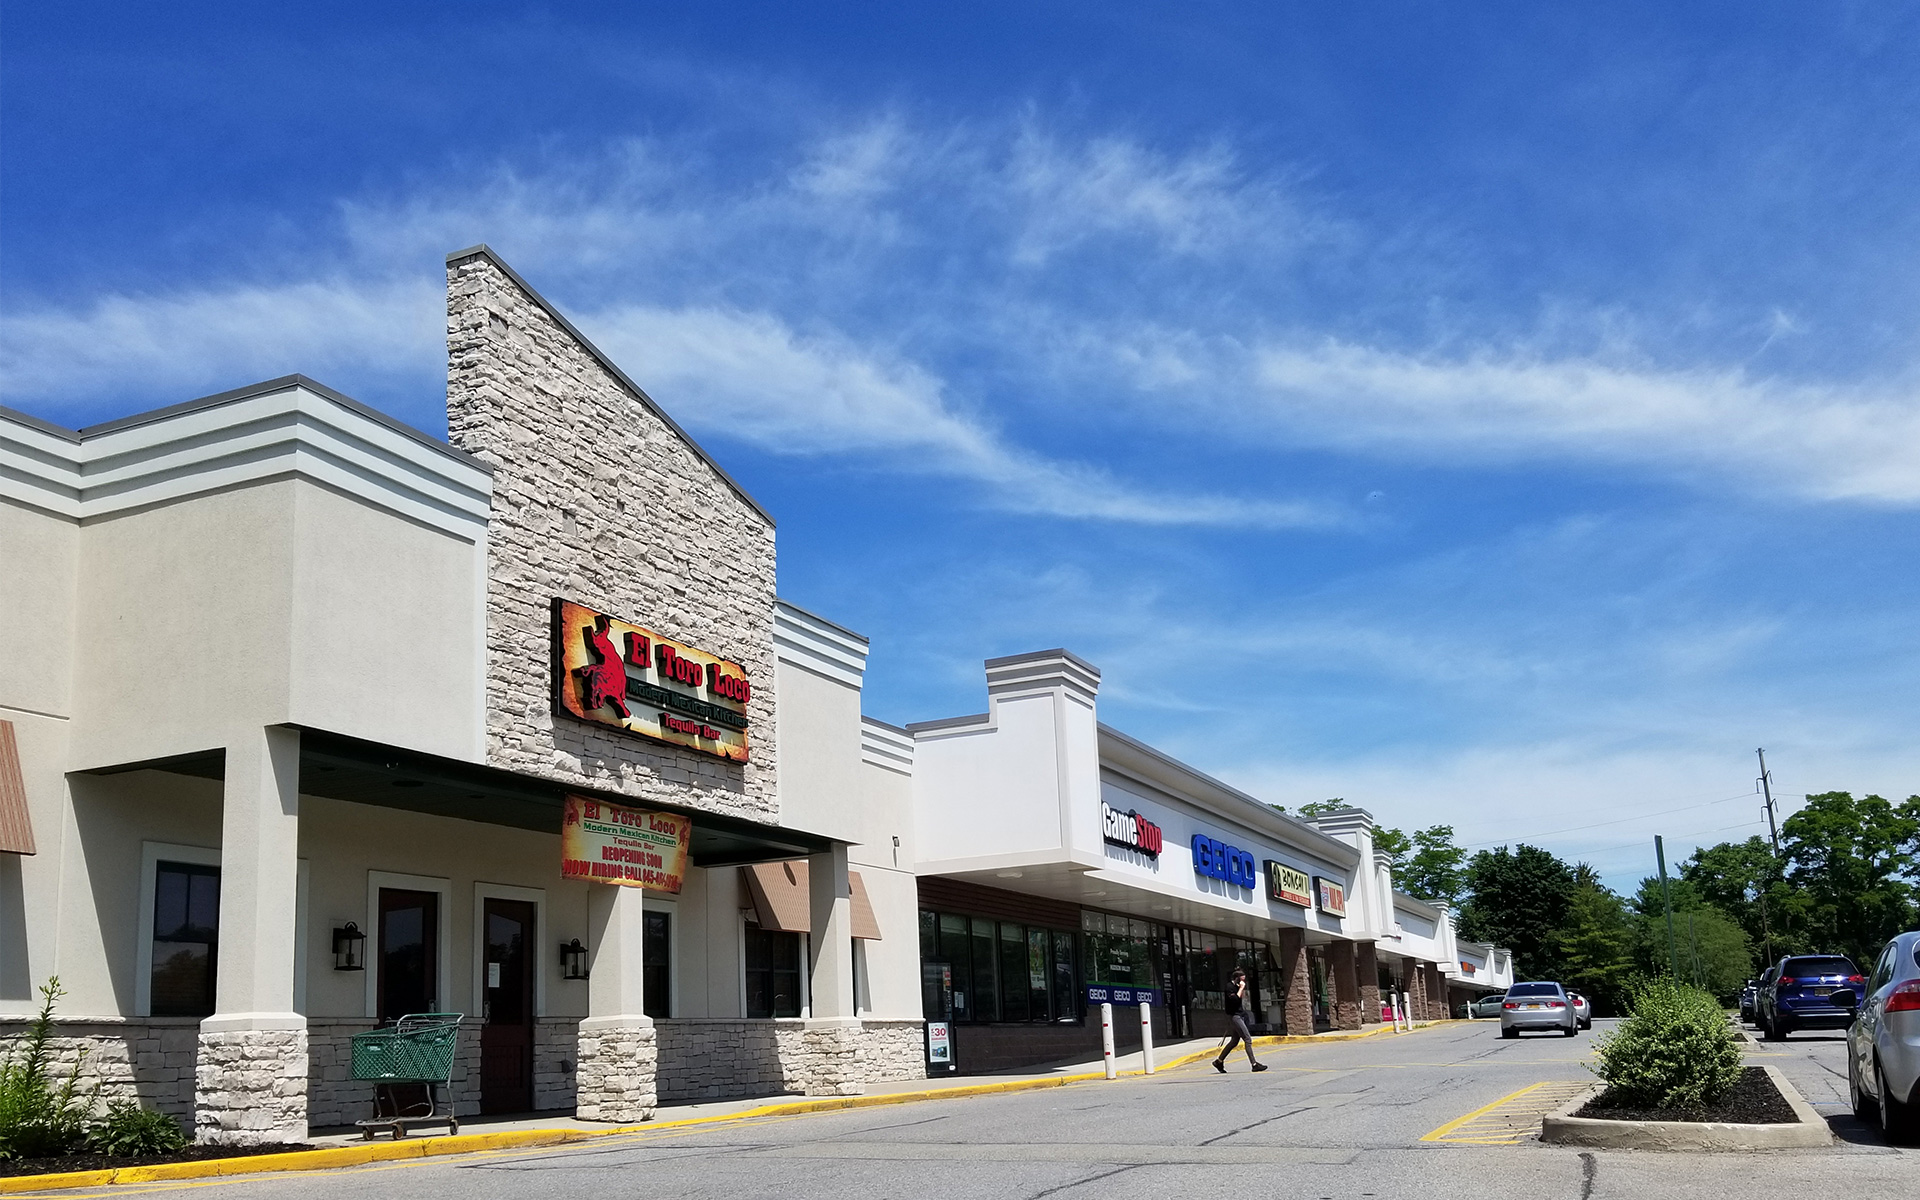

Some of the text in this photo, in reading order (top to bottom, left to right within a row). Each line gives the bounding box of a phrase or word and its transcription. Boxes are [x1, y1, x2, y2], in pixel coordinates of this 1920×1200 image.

[629, 632, 750, 703] El Toro Loco
[629, 679, 749, 728] Modern Mexican Kitchen
[664, 713, 721, 740] Tequila Bar
[584, 802, 676, 835] El Toro Loco
[1102, 801, 1162, 856] GameStop
[584, 822, 676, 846] Modern Mexican Kitchen
[613, 837, 655, 851] Tequila Bar
[563, 859, 591, 876] NOW
[591, 862, 623, 879] HIRING
[624, 865, 642, 881] CALL
[602, 846, 663, 869] REOPENING SOON
[1193, 834, 1256, 890] GEICO
[1282, 869, 1308, 894] BONSAI
[1089, 989, 1152, 1002] GEICO GEICO GEICO
